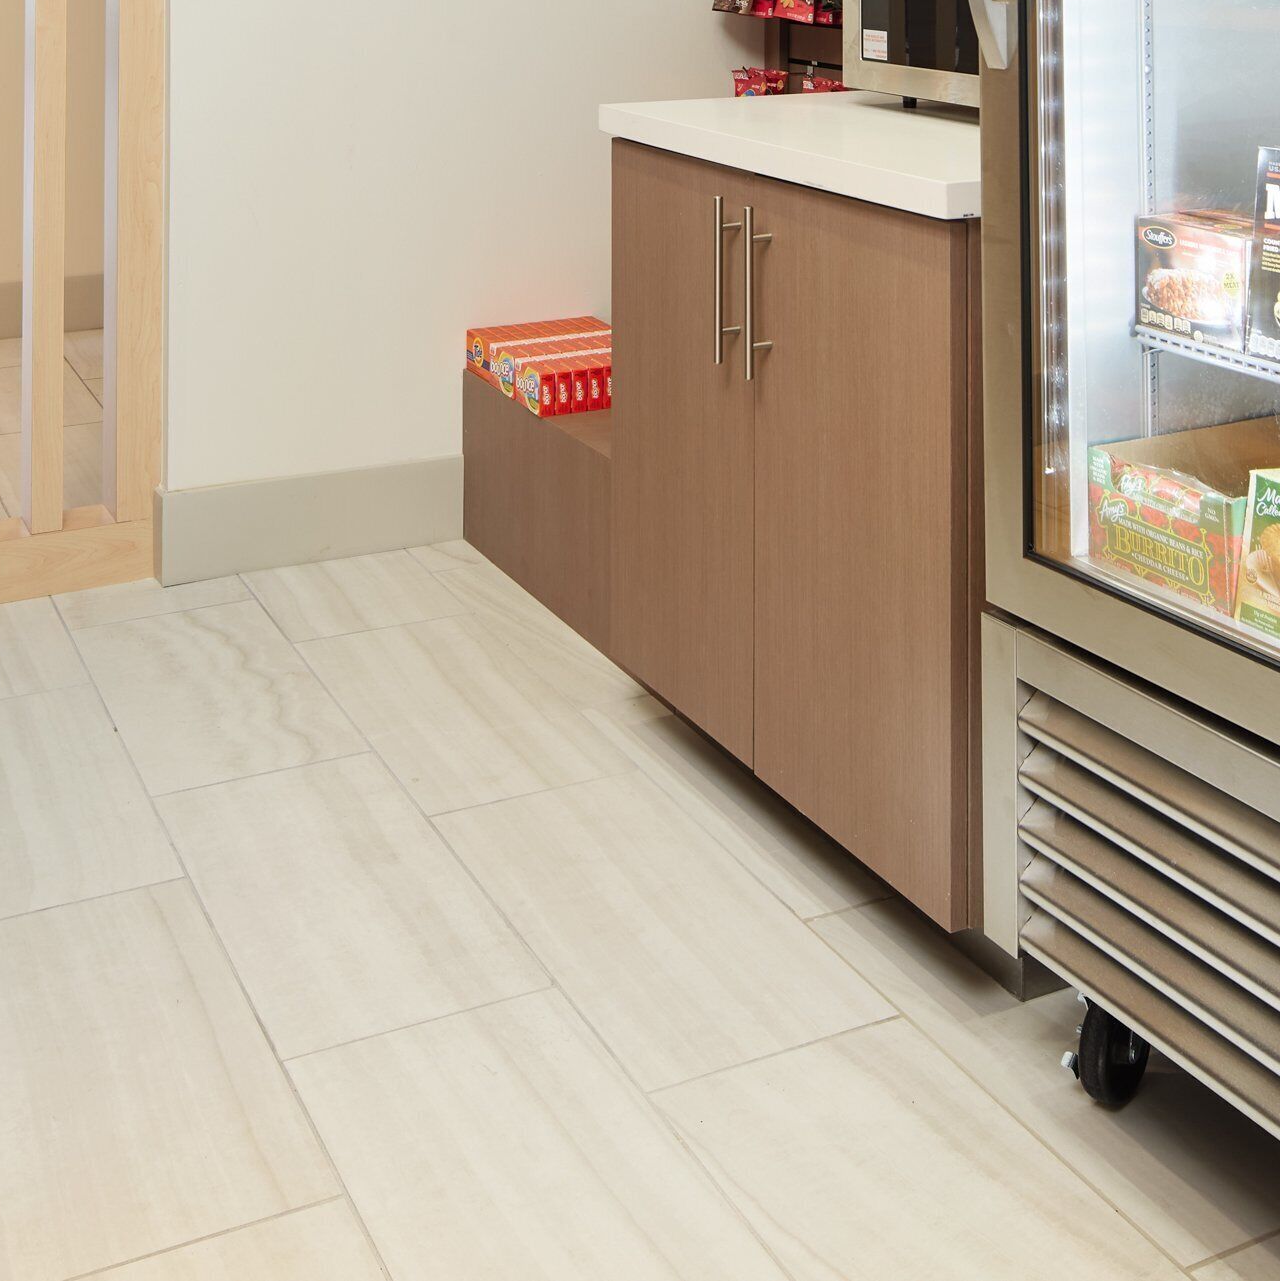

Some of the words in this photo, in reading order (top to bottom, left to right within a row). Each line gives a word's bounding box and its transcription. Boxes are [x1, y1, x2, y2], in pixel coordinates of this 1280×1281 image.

[1145, 229, 1173, 245] Stouffer's
[1263, 245, 1279, 253] FRIED
[1099, 497, 1127, 523] Amy's
[1113, 523, 1205, 586] BURRITO
[1133, 523, 1146, 535] WITH
[1146, 528, 1169, 544] ORGANIC
[1170, 536, 1186, 551] BEANS
[1192, 546, 1204, 559] RICE
[1134, 552, 1163, 571] CHEDDAR
[1163, 565, 1186, 582] CHEESE
